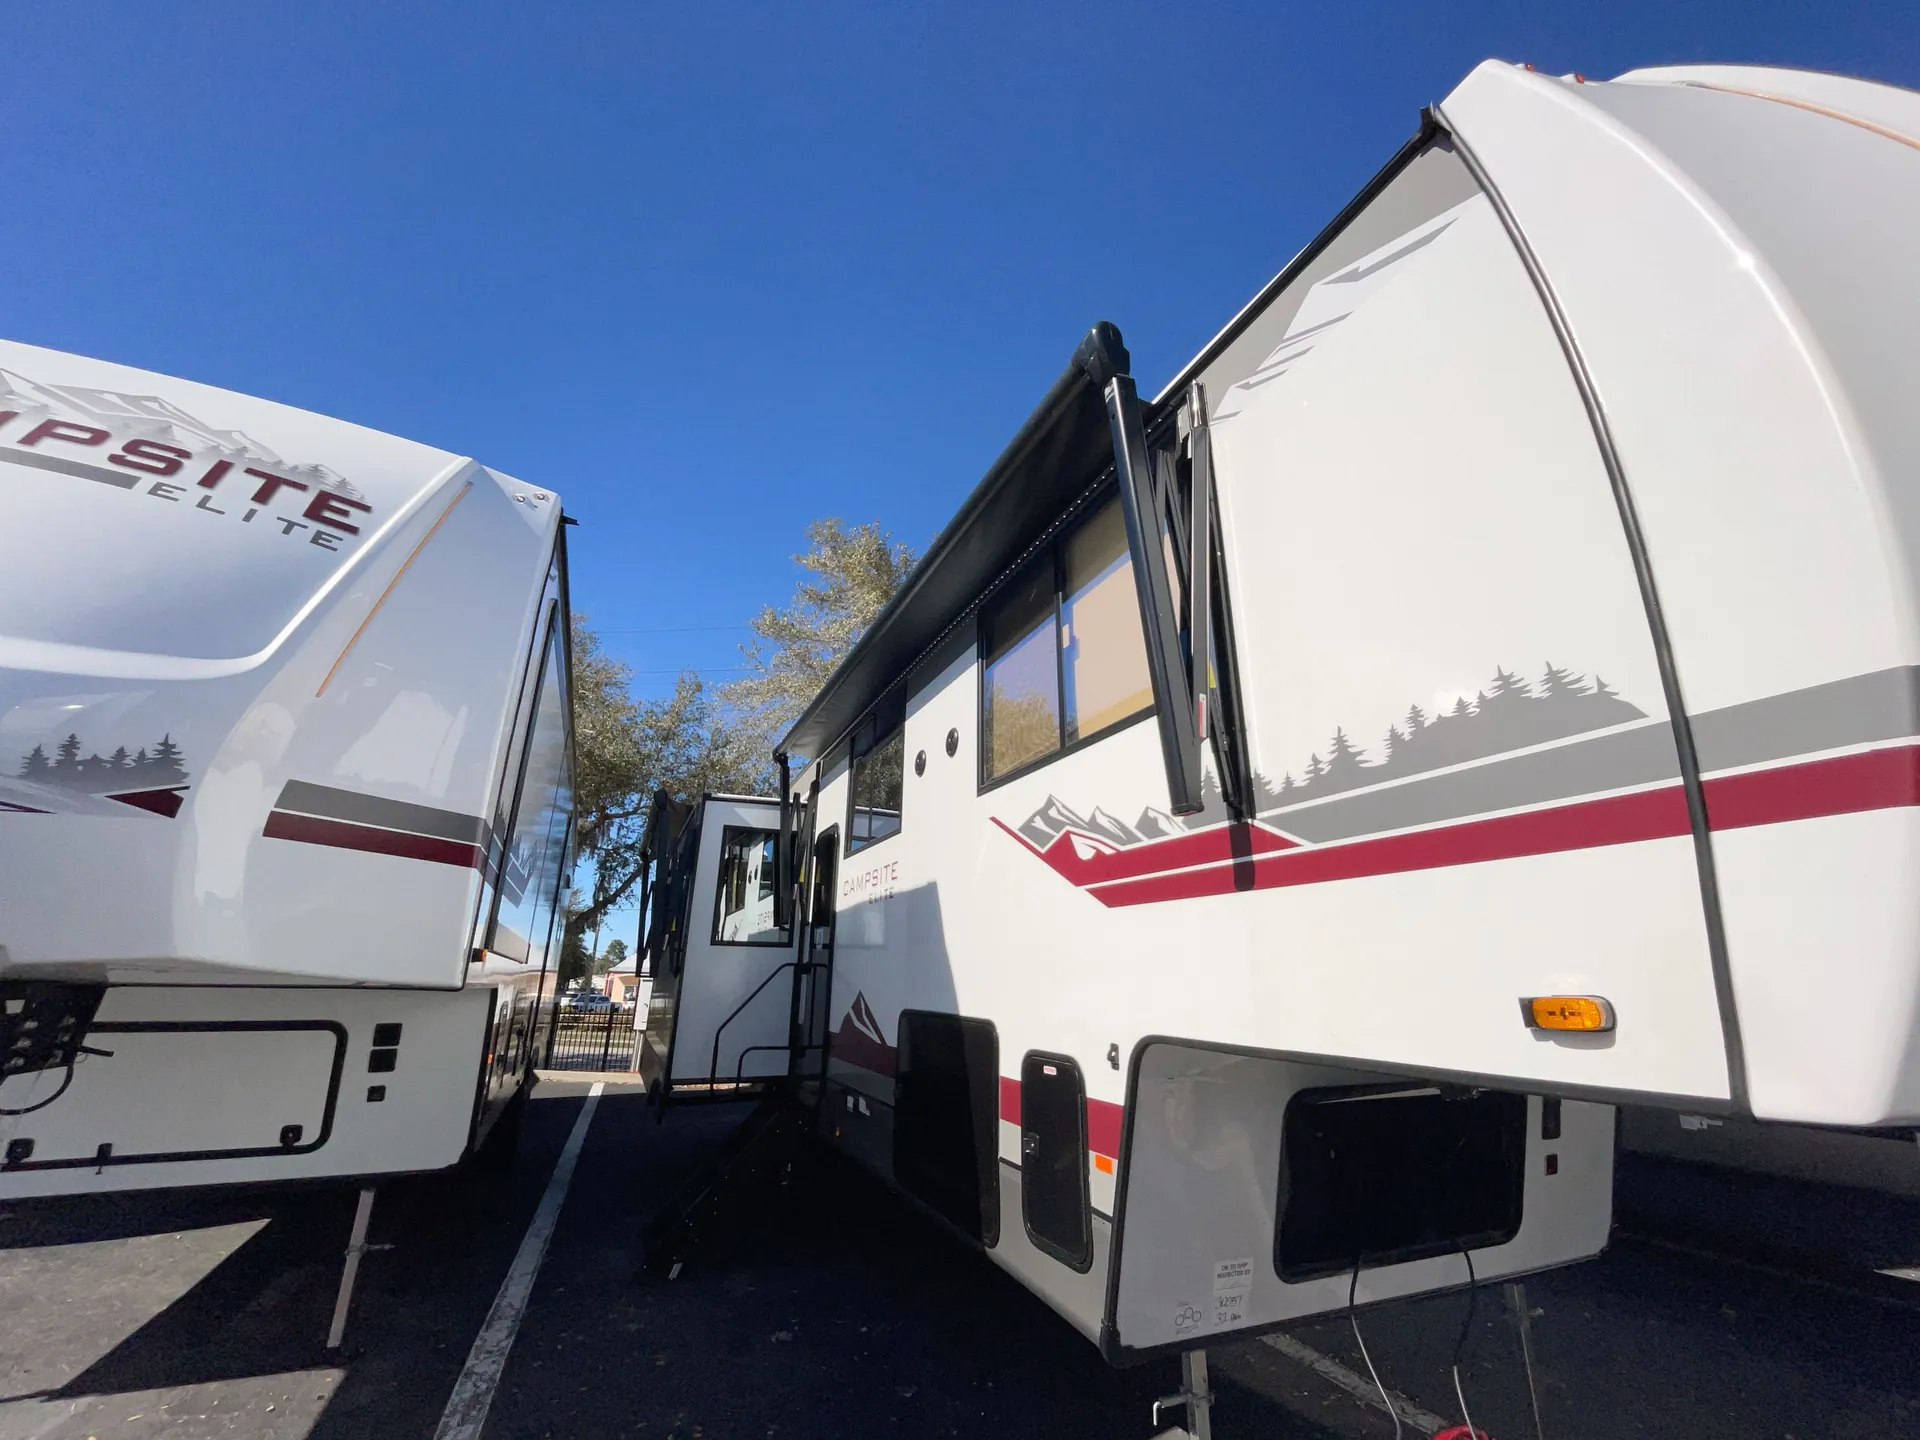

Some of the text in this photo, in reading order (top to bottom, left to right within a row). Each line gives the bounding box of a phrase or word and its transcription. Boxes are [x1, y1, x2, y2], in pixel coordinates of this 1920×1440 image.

[147, 481, 344, 552] ELITE
[843, 861, 898, 896] CAMPSITE
[868, 887, 895, 904] ELITE
